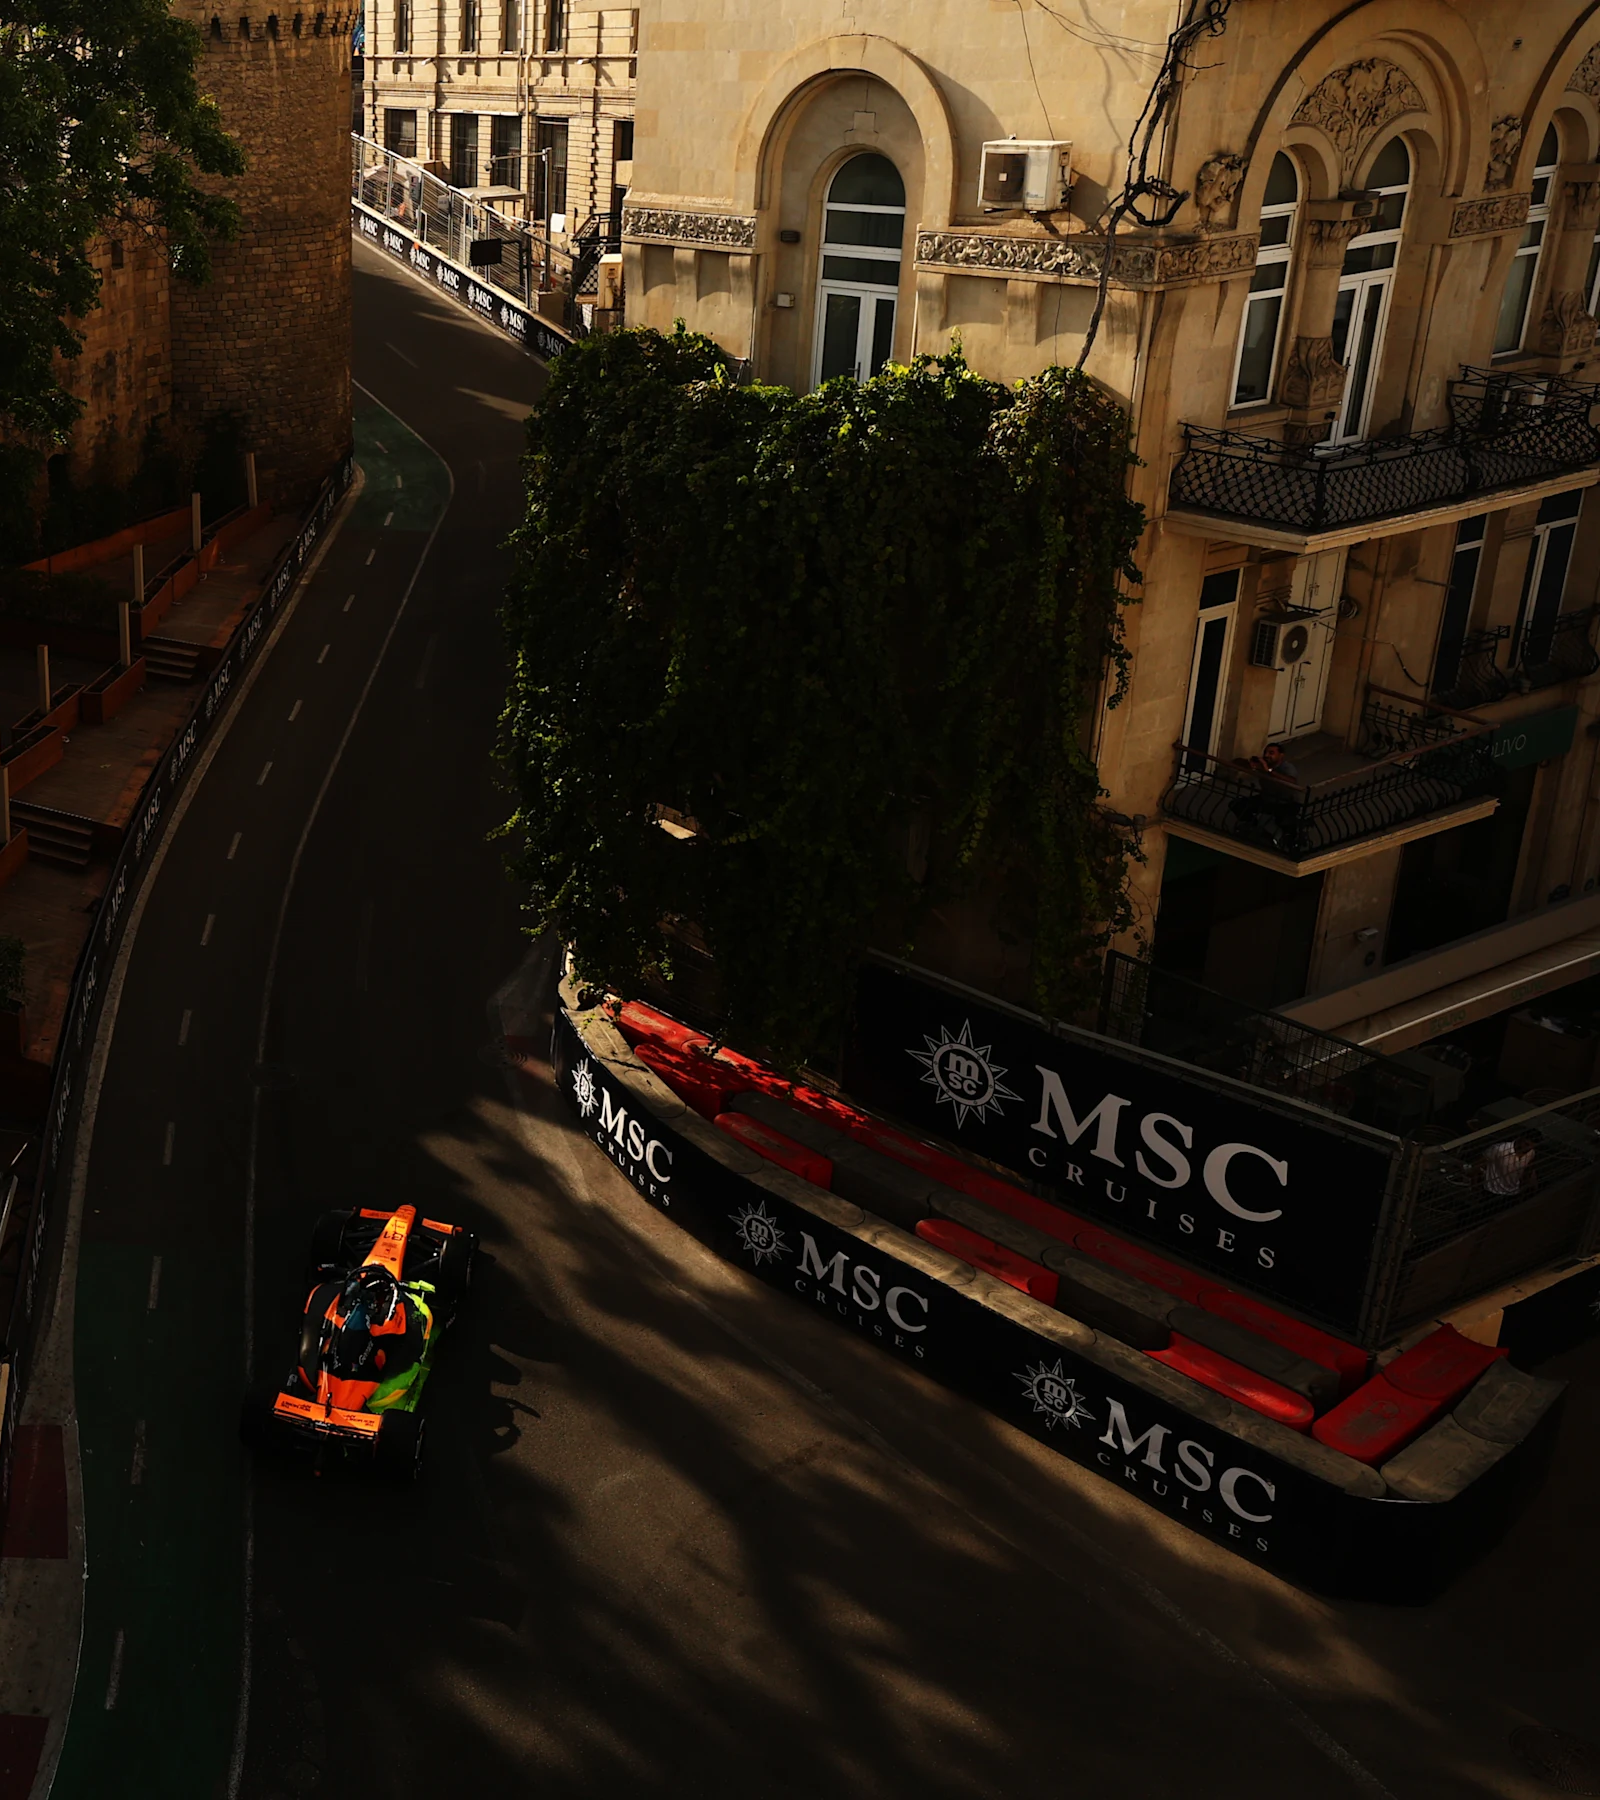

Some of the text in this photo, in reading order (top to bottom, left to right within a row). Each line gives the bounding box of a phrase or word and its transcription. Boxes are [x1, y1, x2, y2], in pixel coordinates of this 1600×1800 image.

[443, 266, 460, 289] MSC
[475, 287, 492, 310] MSC
[509, 309, 527, 333] MSC
[596, 1131, 671, 1208] CRUISES
[598, 1086, 673, 1183] MSC
[1030, 1064, 1289, 1223] MSC
[1028, 1148, 1276, 1270] CRUISES
[795, 1279, 925, 1359] CRUISES
[796, 1231, 929, 1333] MSC
[1096, 1452, 1269, 1552] CRUISES
[1099, 1396, 1276, 1523] MSC
